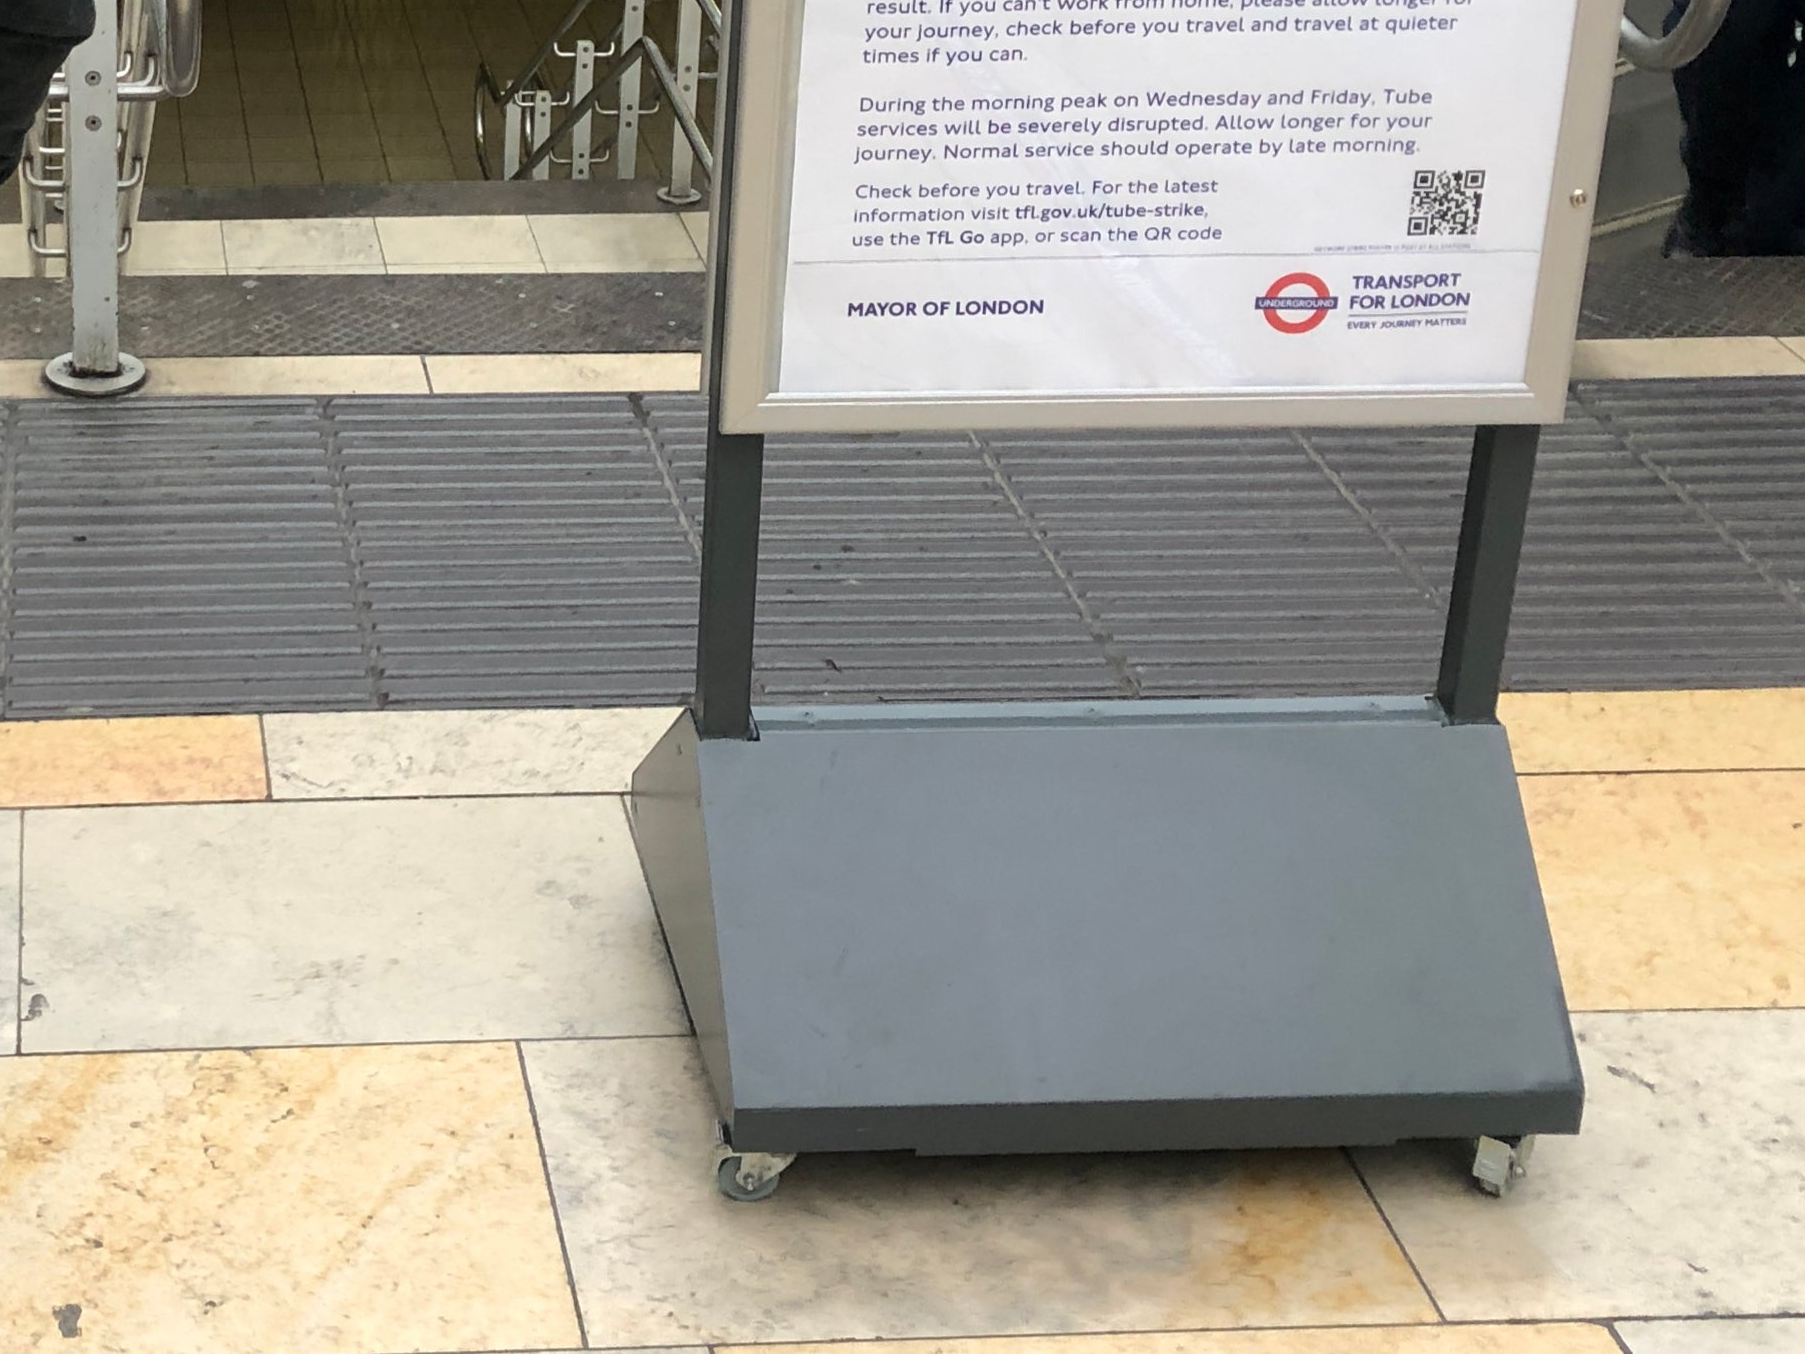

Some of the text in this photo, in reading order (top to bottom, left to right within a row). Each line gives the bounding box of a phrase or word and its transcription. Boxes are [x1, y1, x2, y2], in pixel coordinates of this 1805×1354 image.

[856, 184, 912, 199] Check
[919, 183, 980, 198] before
[986, 185, 1020, 200] you
[1092, 180, 1122, 195] For
[1128, 180, 1158, 194] the
[1165, 180, 1218, 193] latest
[854, 208, 964, 222] information
[971, 207, 1009, 220] visit
[853, 236, 884, 247] use
[890, 232, 920, 246] the
[926, 230, 954, 245] TfL
[960, 230, 984, 244] Go
[1035, 232, 1055, 243] or
[1060, 231, 1101, 242] scan
[1108, 227, 1138, 241] the
[1144, 227, 1171, 241] QR
[1178, 226, 1222, 240] code
[1352, 273, 1462, 289] TRANSPORT
[848, 299, 1044, 317] MAYOR OF LONDON
[1259, 299, 1334, 307] UNDERGROUND
[1349, 292, 1471, 309] FOR LONDON
[1347, 317, 1467, 330] EVERY JOURNEY MATTERS
